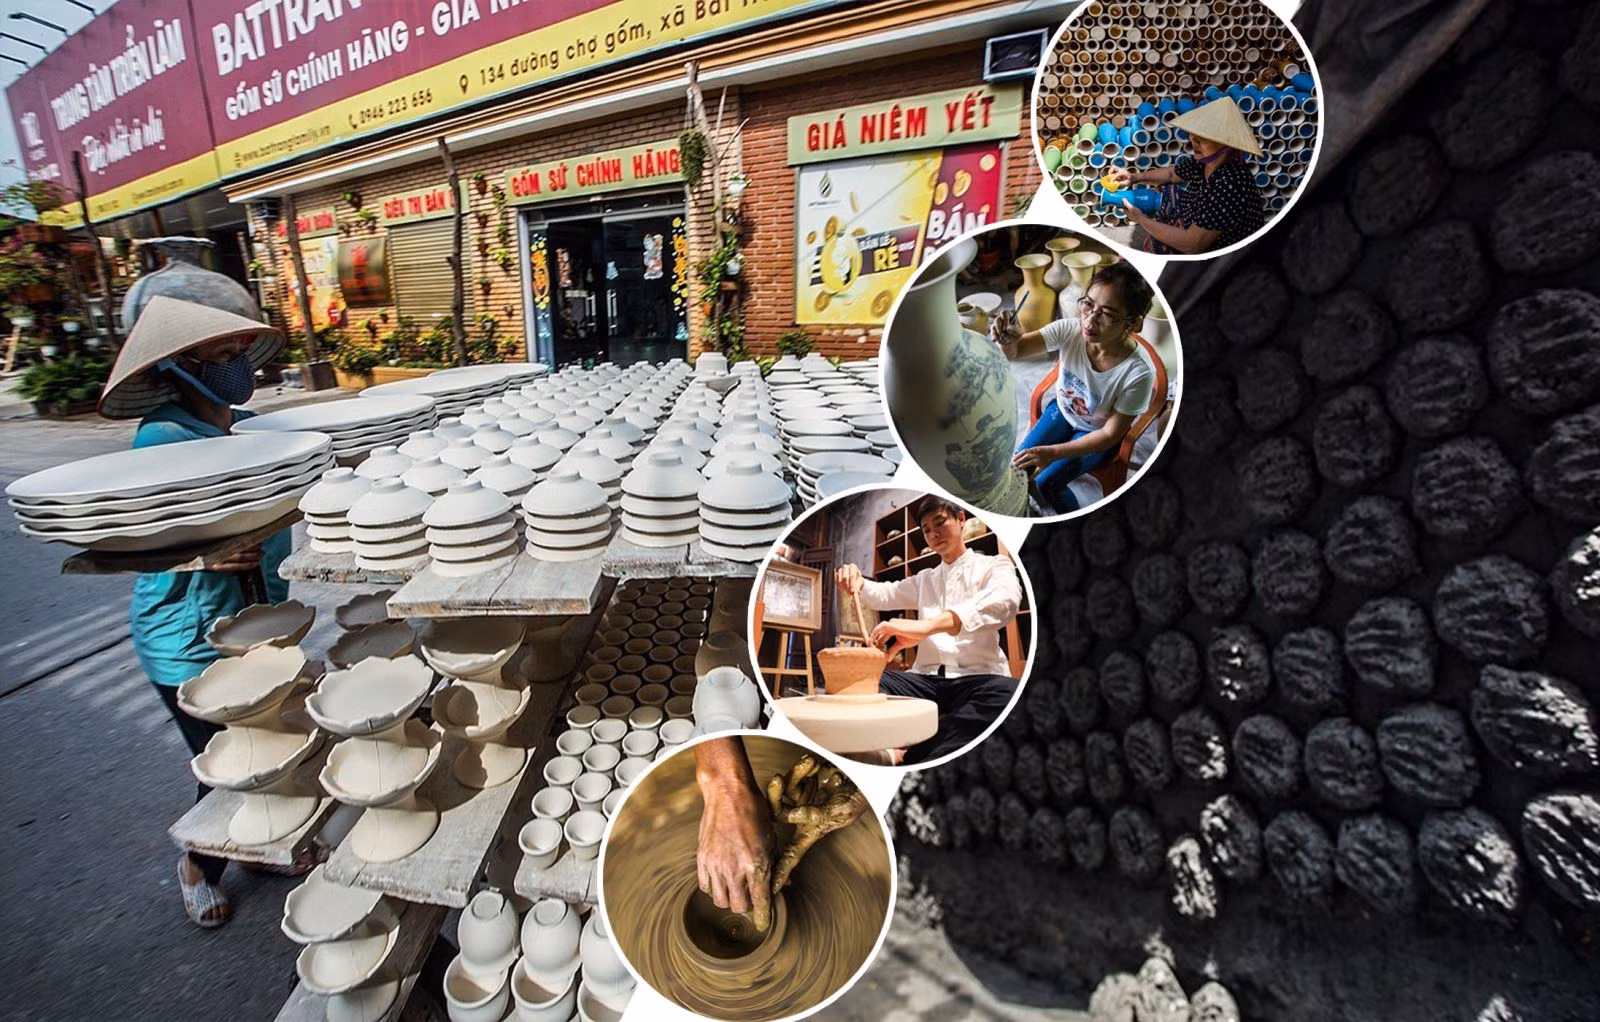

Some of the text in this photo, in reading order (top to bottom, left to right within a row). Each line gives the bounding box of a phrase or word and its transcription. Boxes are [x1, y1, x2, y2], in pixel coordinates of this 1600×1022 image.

[225, 81, 261, 120] GỐM
[285, 52, 343, 96] CHÍNH
[346, 28, 408, 72] HÃNG
[480, 64, 505, 85] 134
[511, 50, 559, 76] đường
[566, 35, 598, 59] chợ
[605, 18, 651, 53] gốm,
[660, 5, 685, 32] xã
[360, 88, 433, 123] 0946 223 656
[807, 90, 996, 151] GIÁ NIÊM YẾT
[512, 148, 681, 197] GỐM SỨ CHÍNH HÃNG
